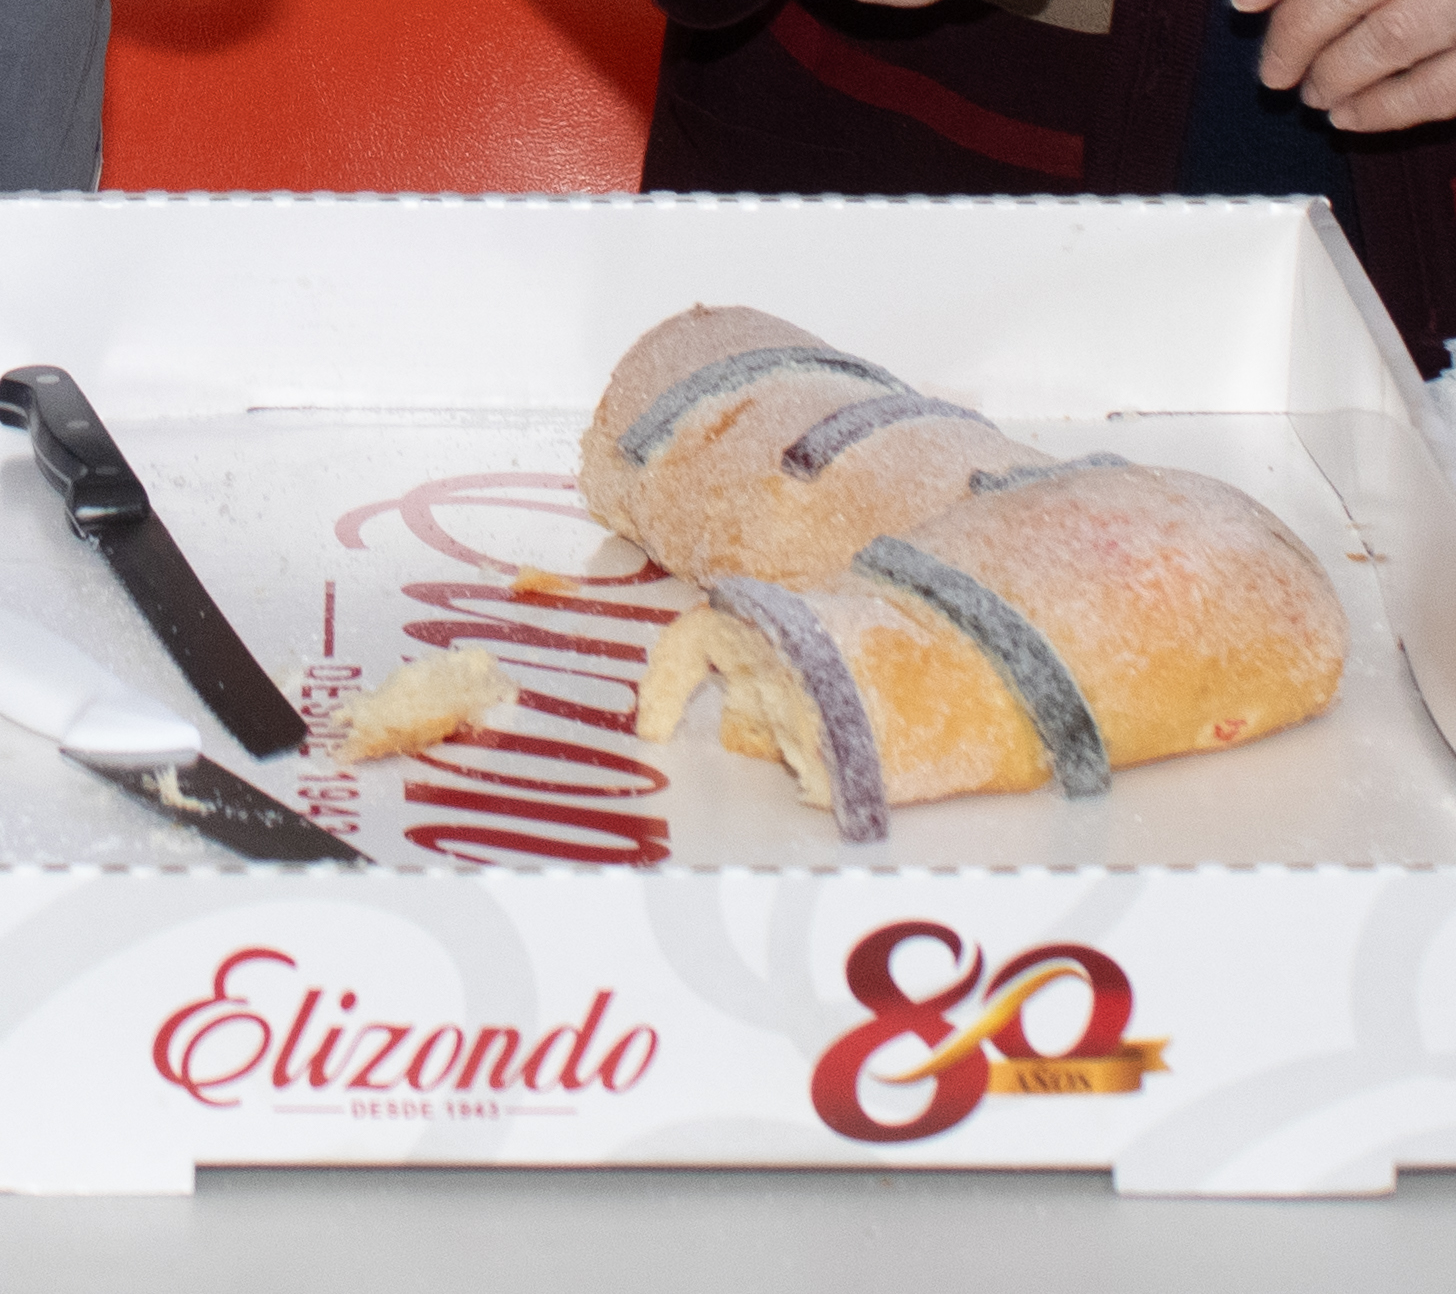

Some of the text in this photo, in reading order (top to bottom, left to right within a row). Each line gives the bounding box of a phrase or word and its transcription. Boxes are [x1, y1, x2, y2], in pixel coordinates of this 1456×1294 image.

[152, 944, 660, 1109] Elizondo
[810, 919, 1134, 1144] 80
[351, 1098, 435, 1122] DESDE
